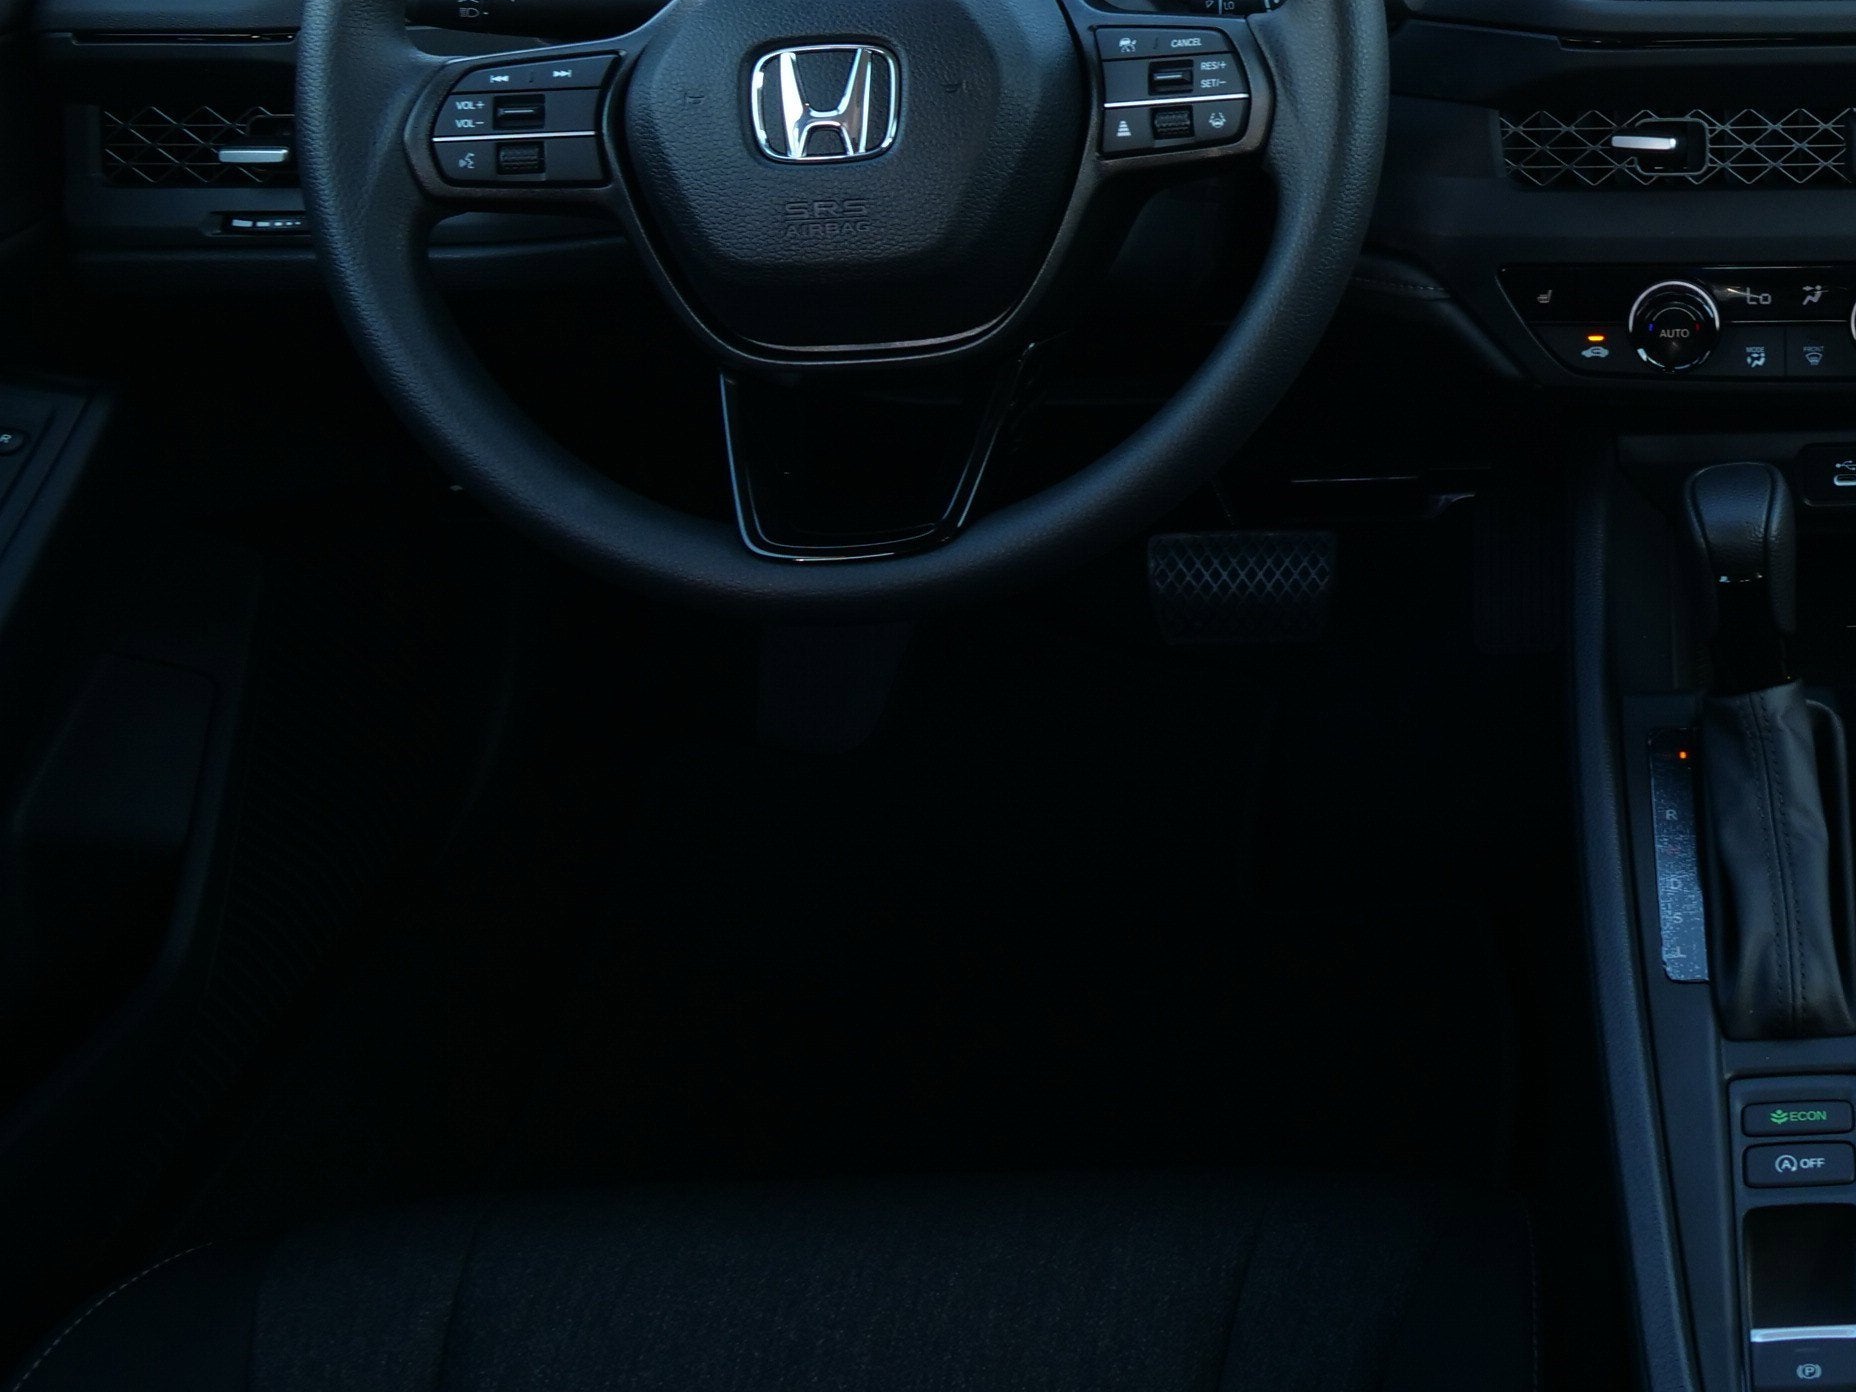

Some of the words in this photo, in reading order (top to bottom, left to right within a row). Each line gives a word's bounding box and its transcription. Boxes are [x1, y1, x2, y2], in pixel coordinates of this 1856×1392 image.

[1223, 1, 1235, 10] LO
[1170, 38, 1202, 48] CANCEL
[785, 199, 869, 217] SRS
[785, 220, 872, 238] AIRBAG
[1659, 329, 1690, 338] AUTO
[1803, 345, 1824, 353] FRONT
[1665, 809, 1678, 821] R
[1673, 912, 1683, 924] S
[1789, 1110, 1828, 1122] ECON
[1800, 1157, 1826, 1169] OFF
